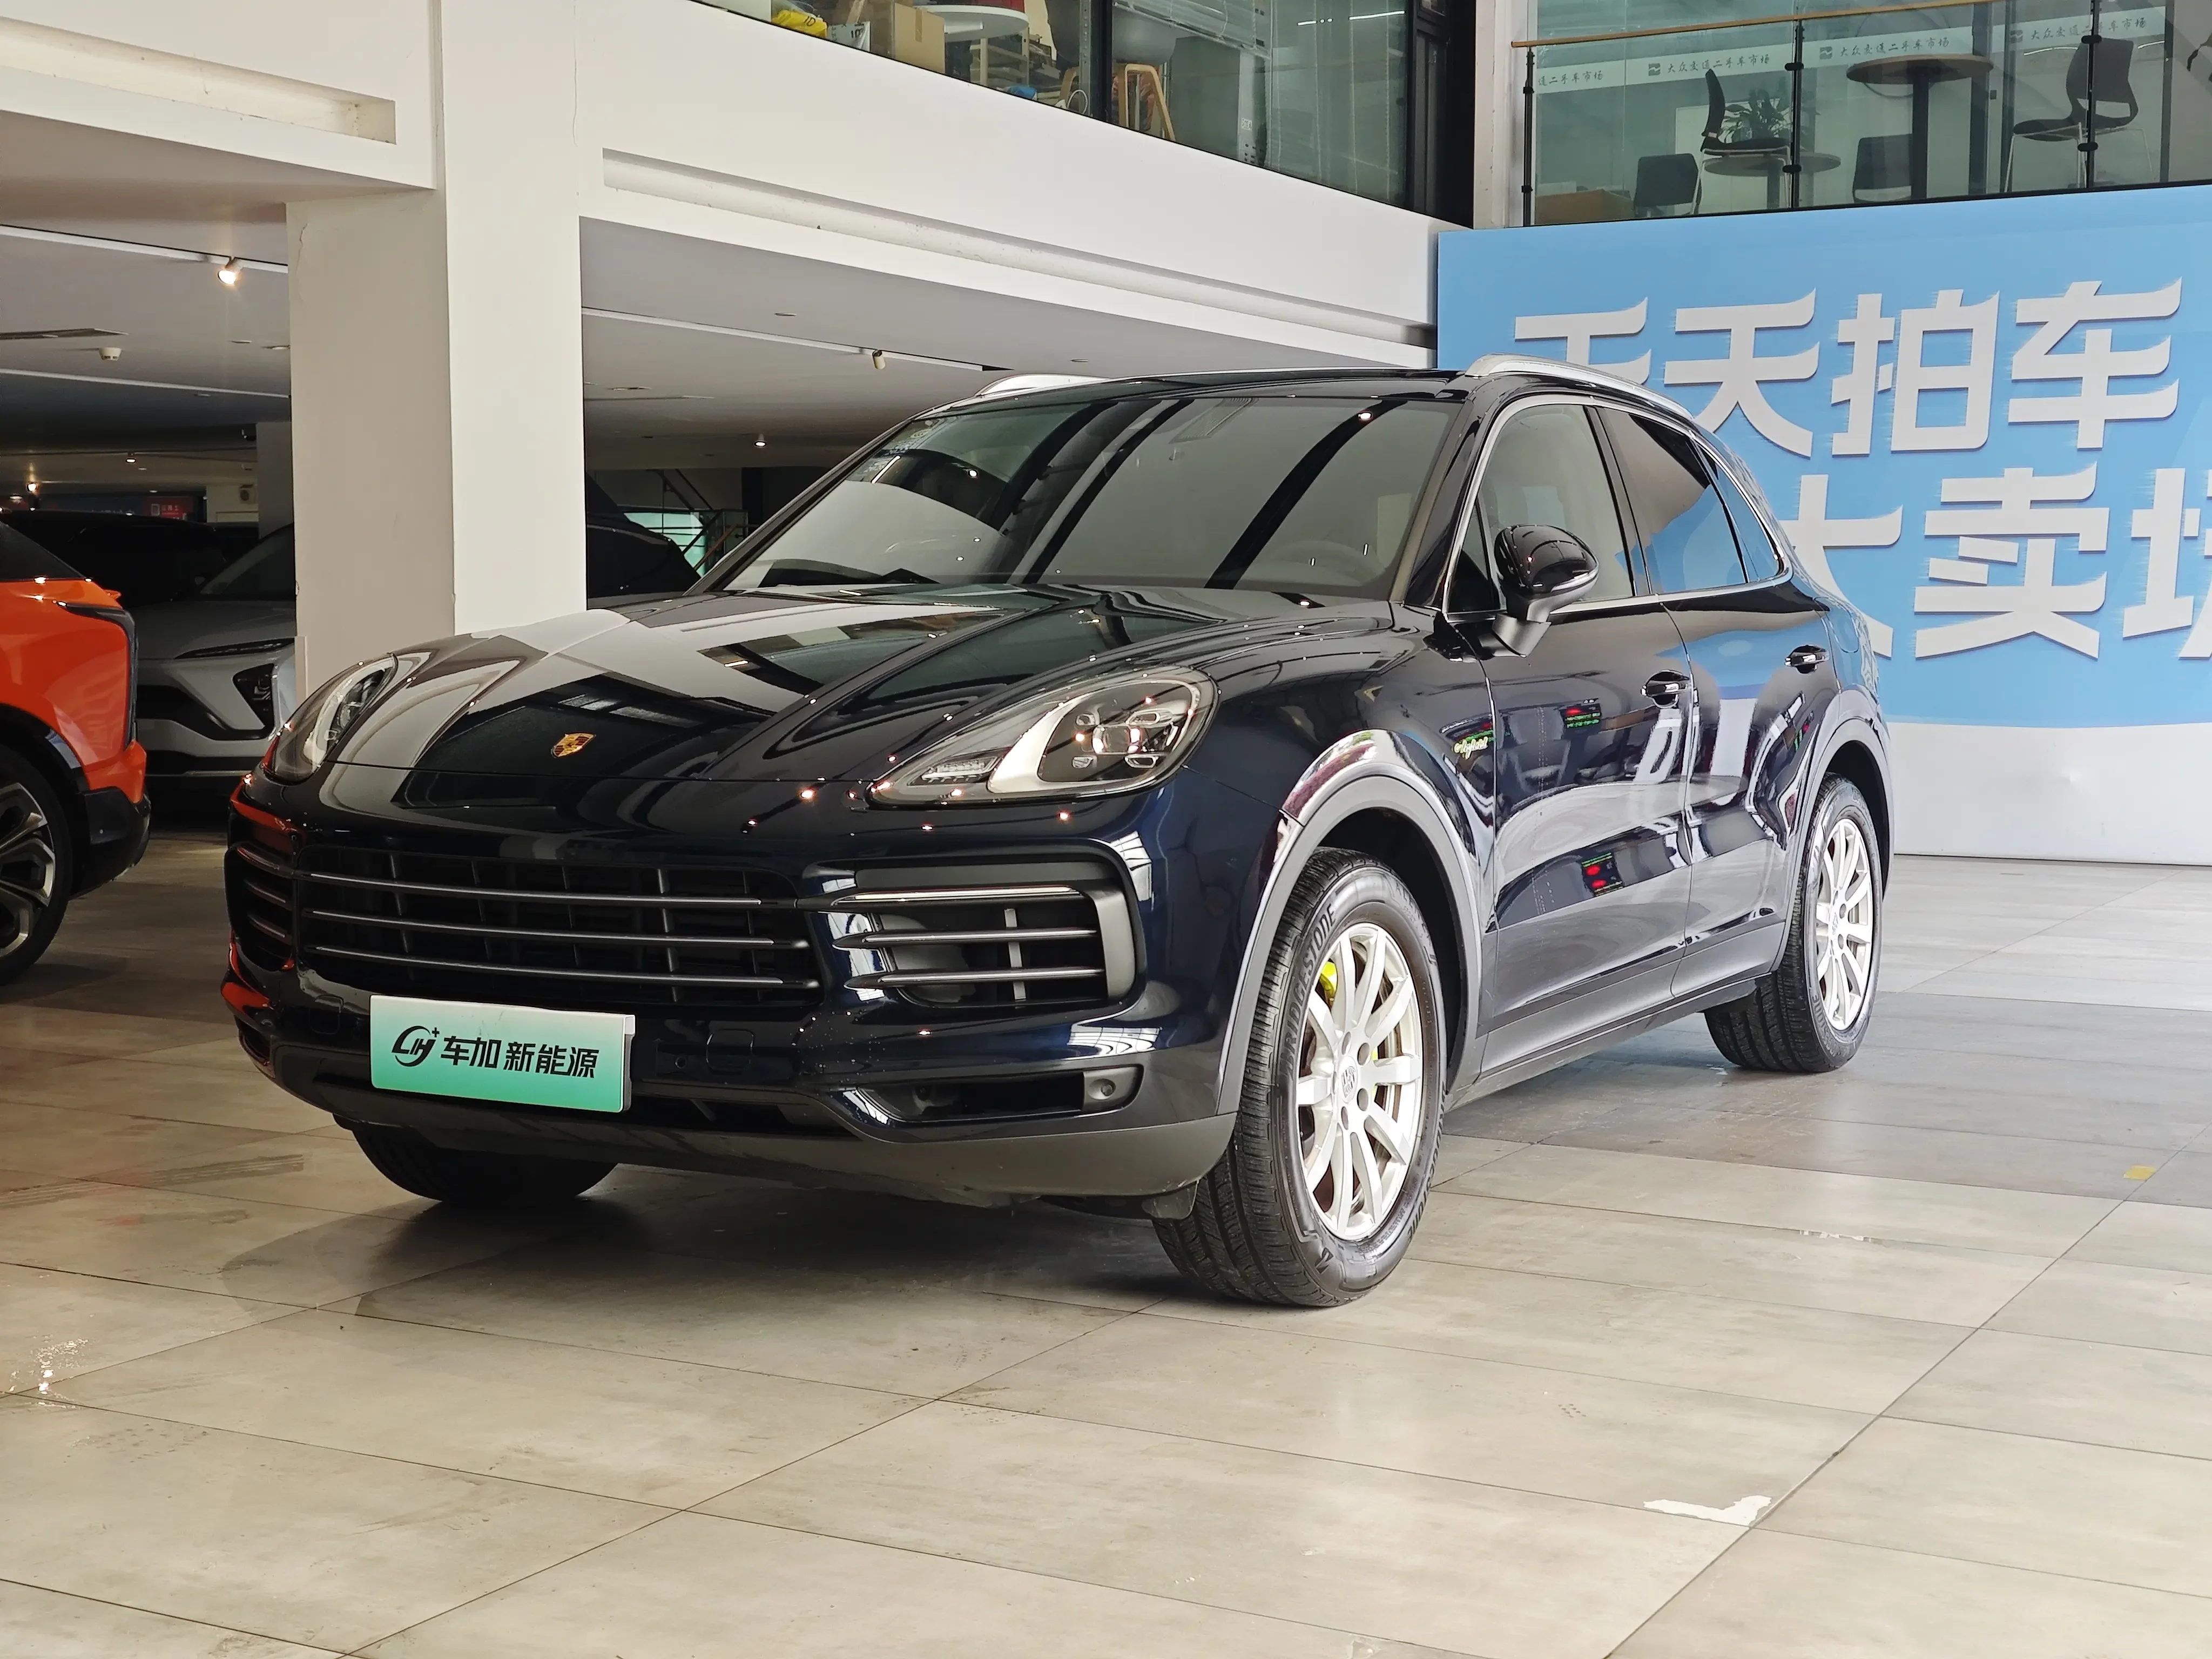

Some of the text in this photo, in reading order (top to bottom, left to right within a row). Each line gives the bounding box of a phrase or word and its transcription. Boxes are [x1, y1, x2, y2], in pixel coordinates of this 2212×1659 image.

[440, 1035, 599, 1079] 车加新能源
